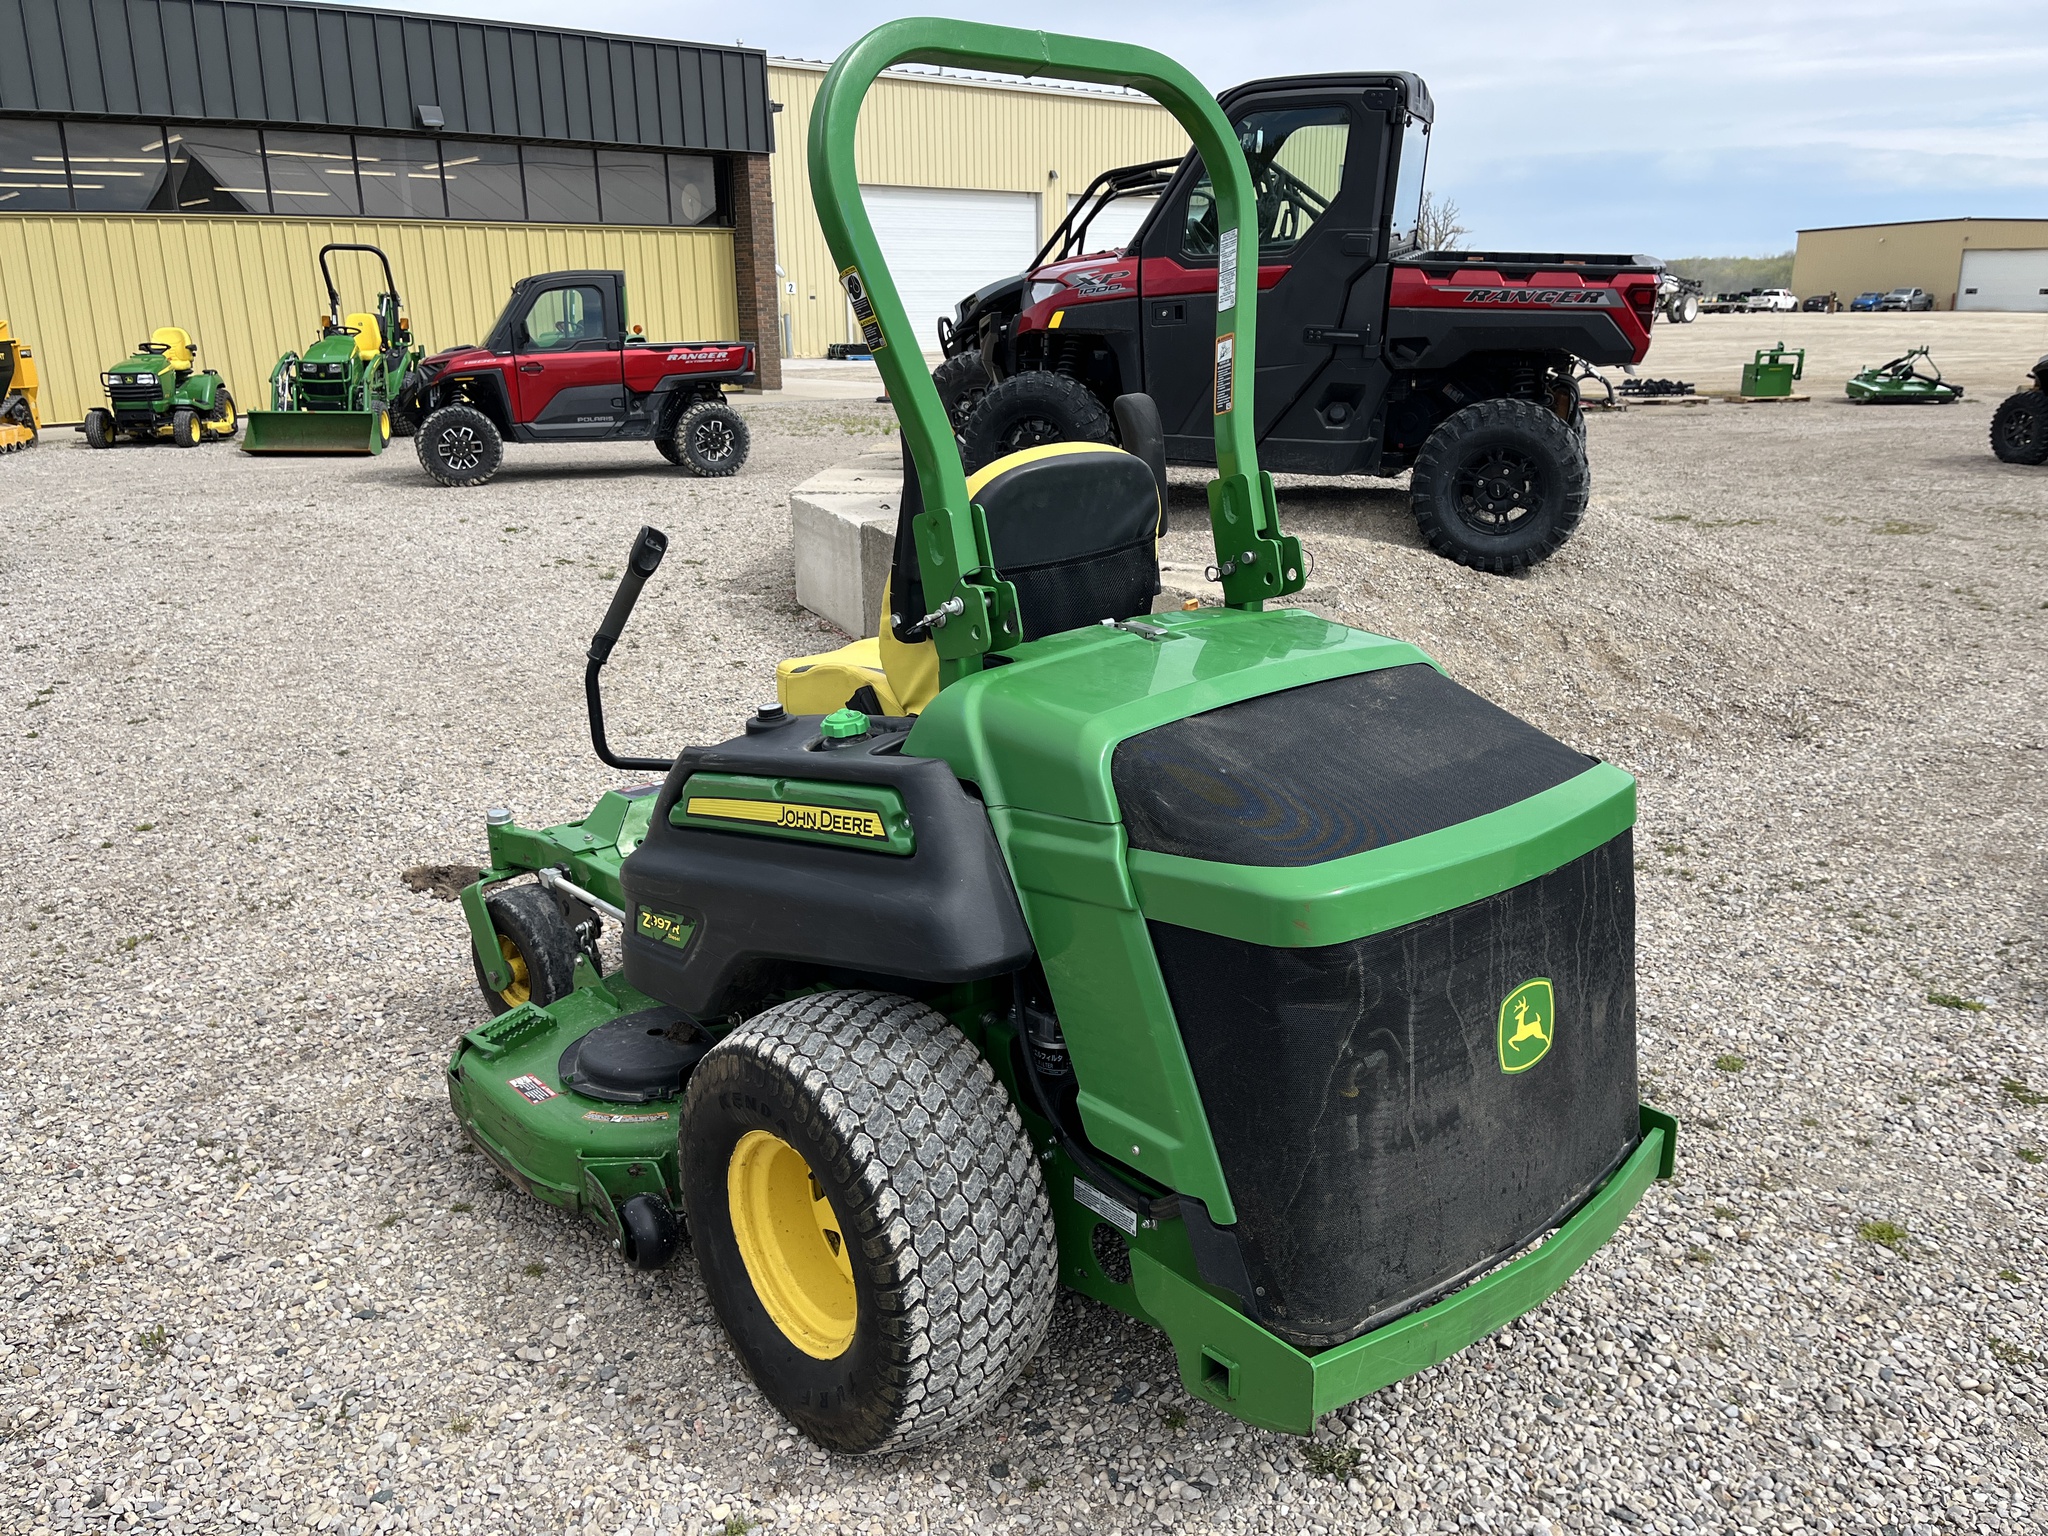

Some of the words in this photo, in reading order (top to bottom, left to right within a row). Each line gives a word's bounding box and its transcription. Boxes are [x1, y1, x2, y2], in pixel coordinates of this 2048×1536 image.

[1073, 270, 1132, 289] XP
[788, 283, 794, 293] 2
[1079, 284, 1122, 295] 1000
[1464, 289, 1606, 304] RANGER
[666, 351, 729, 361] RANGER
[577, 415, 615, 423] POLARIS
[777, 806, 817, 828] JOHN
[820, 810, 874, 834] DEERE
